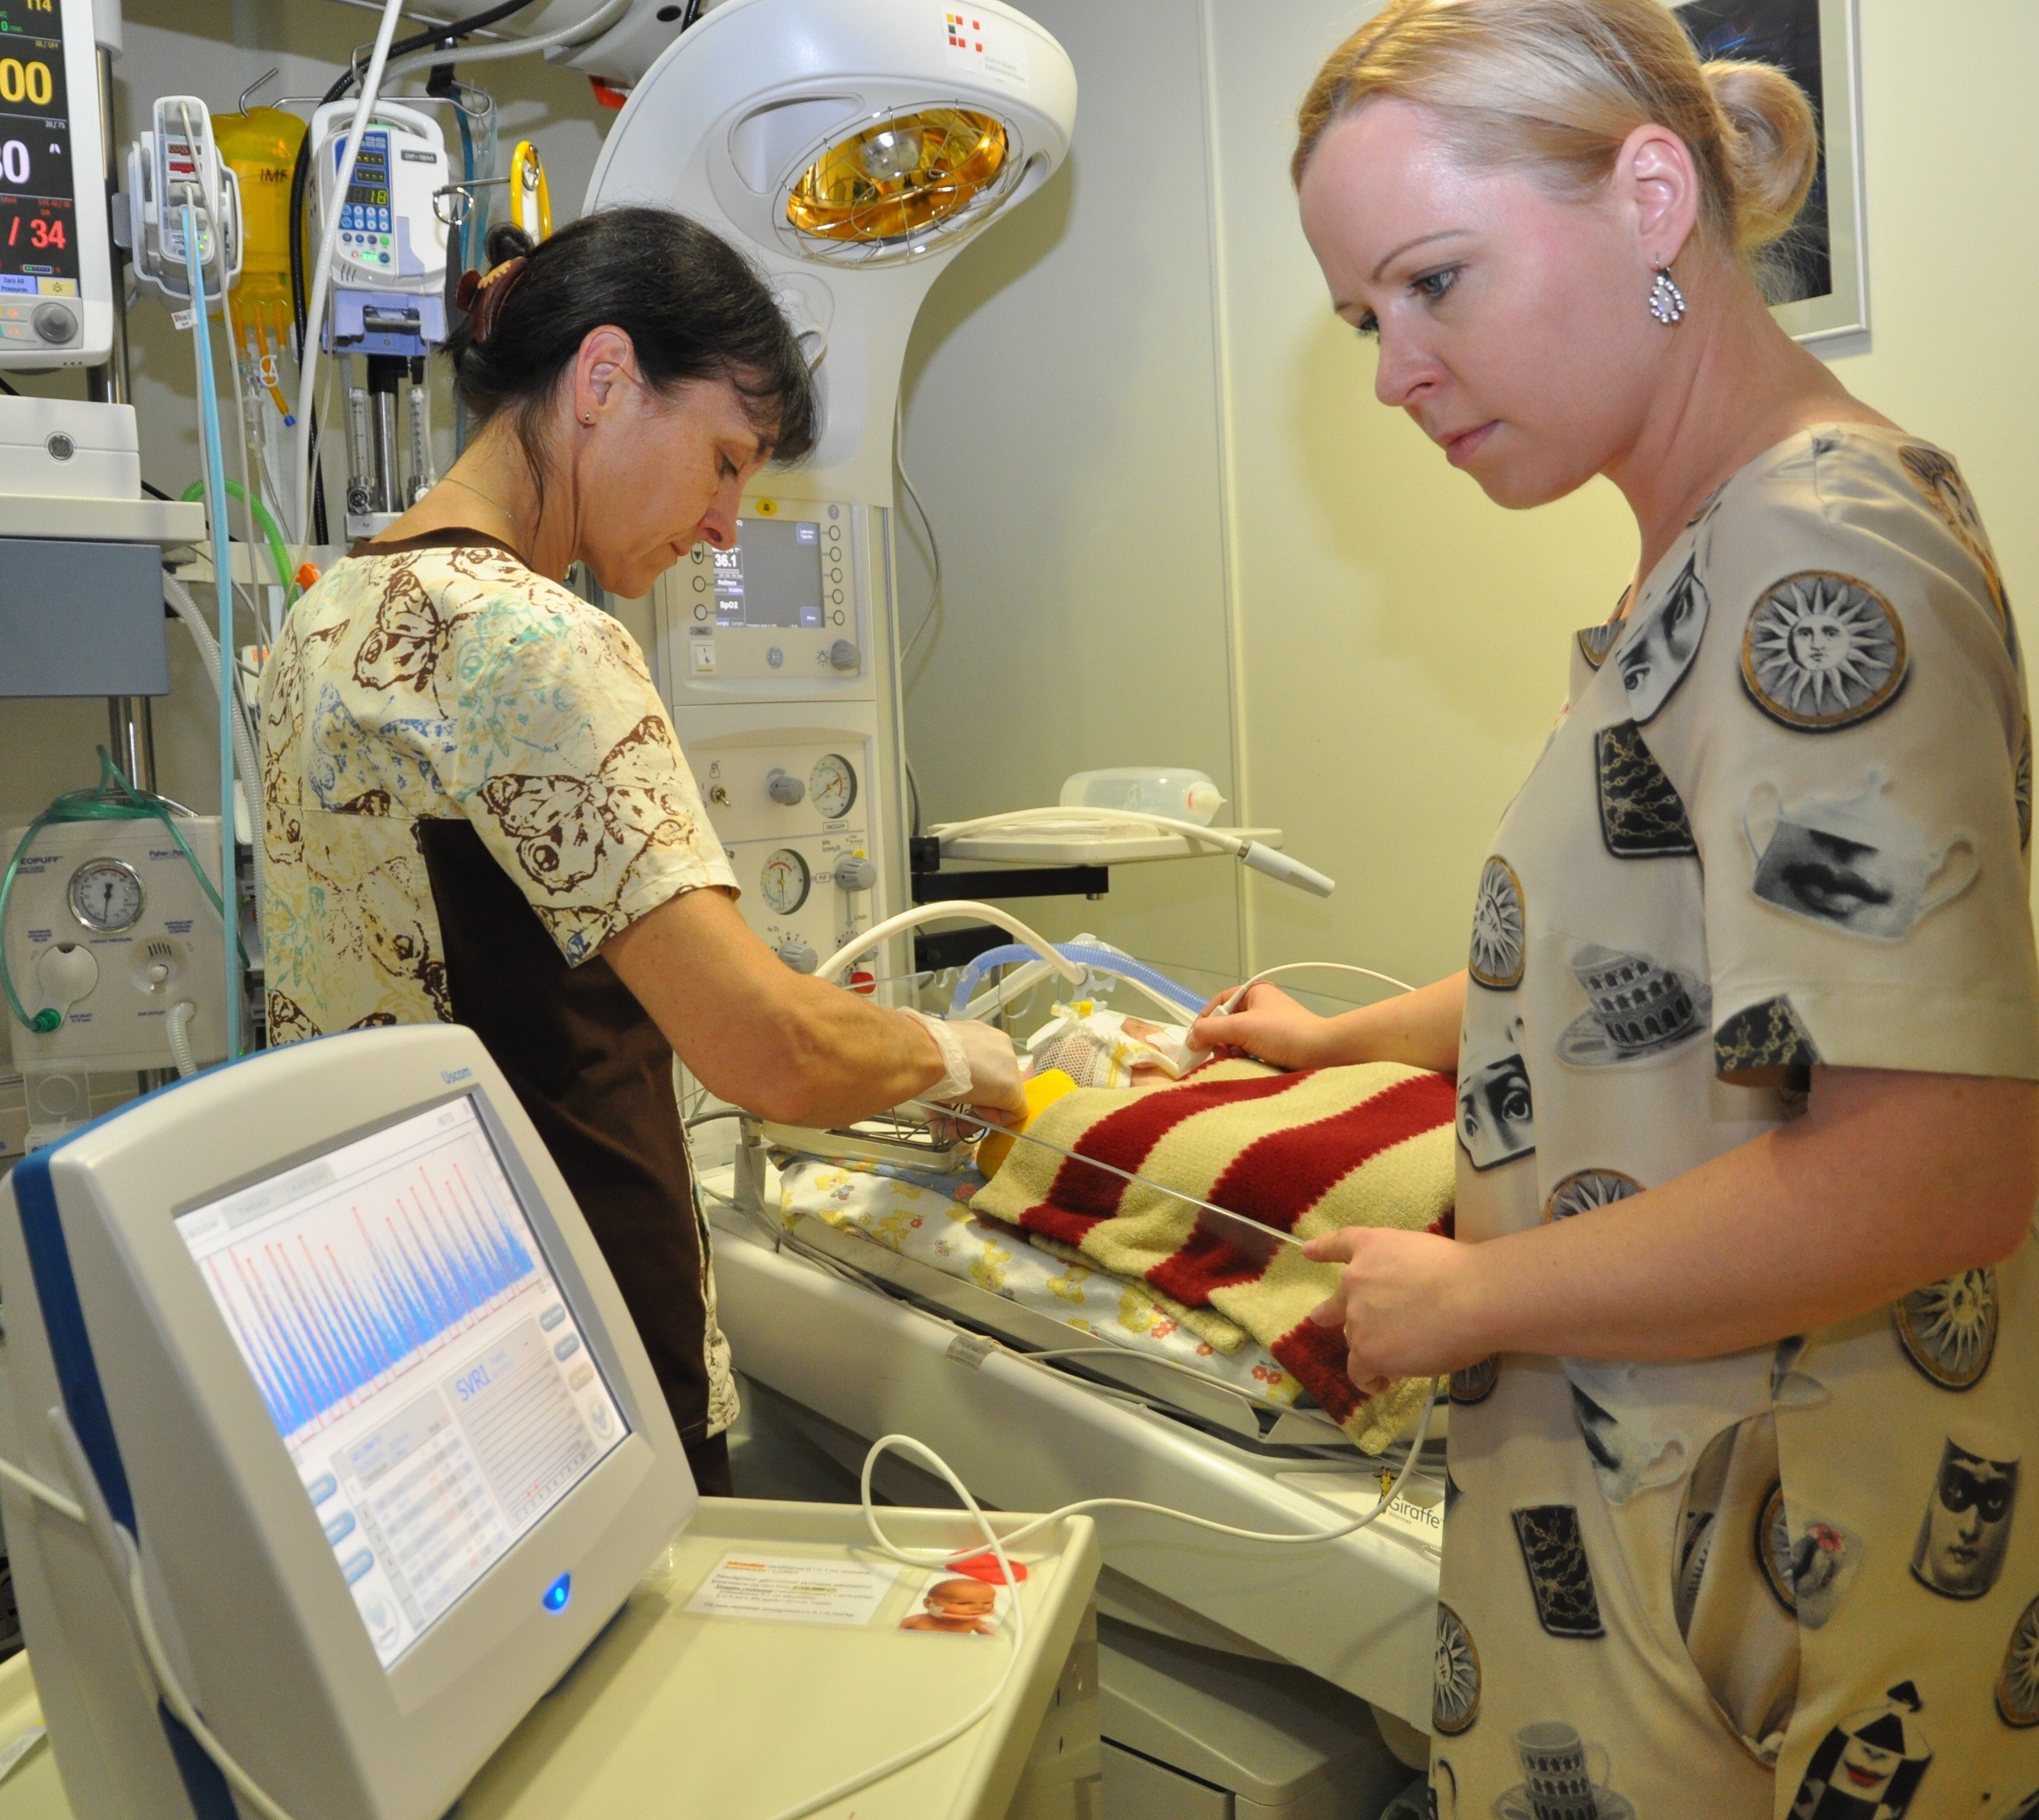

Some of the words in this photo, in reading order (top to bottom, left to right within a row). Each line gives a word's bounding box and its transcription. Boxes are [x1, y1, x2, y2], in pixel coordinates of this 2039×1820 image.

[0, 140, 30, 184] 0
[30, 218, 66, 249] 34
[715, 554, 737, 567] 36.1
[720, 600, 738, 610] SpO2
[20, 855, 59, 865] EOPUFF
[441, 1067, 473, 1085] Uscom
[455, 1364, 490, 1402] SVRI
[1388, 1511, 1412, 1525] Warmer
[1389, 1497, 1440, 1528] Giraffe
